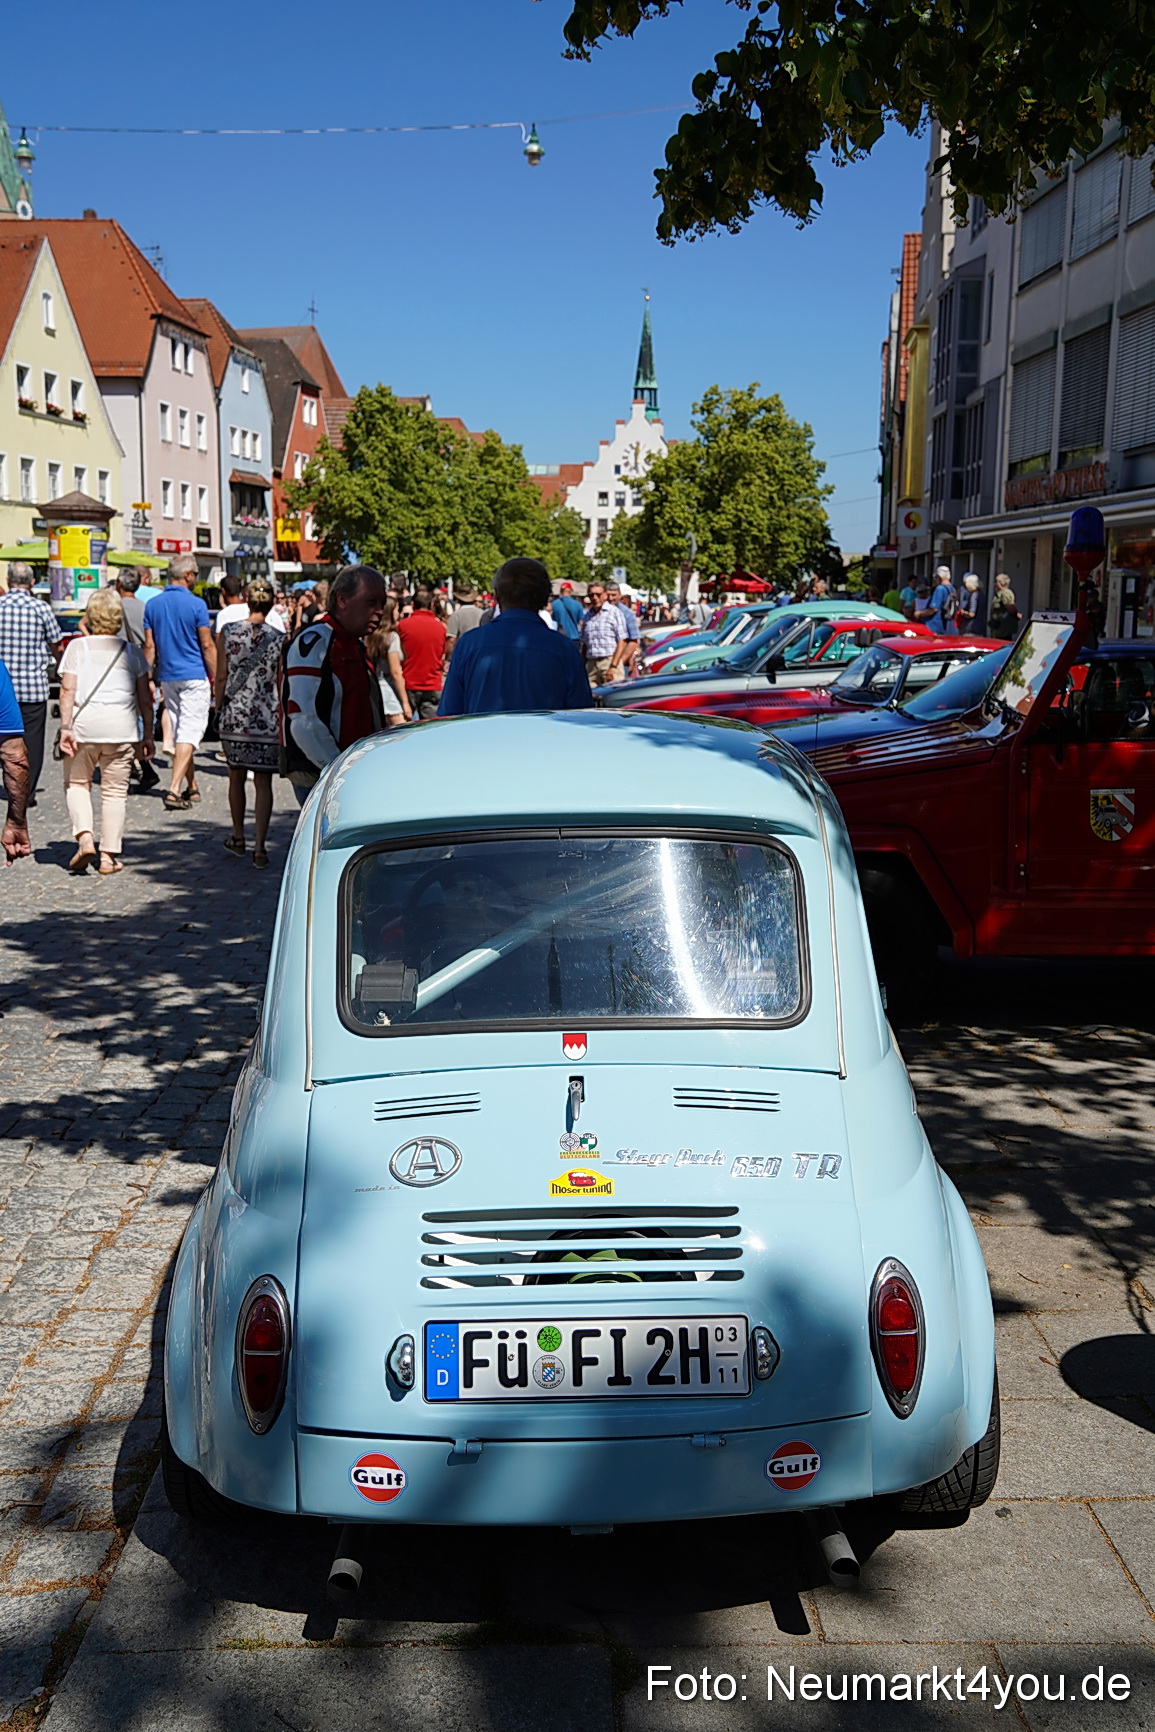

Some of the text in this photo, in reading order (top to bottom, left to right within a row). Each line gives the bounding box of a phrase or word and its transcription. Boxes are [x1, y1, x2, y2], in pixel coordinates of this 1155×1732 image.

[1043, 463, 1106, 500] APOTHEKE
[674, 1149, 726, 1168] Puch
[730, 1155, 783, 1179] 650
[791, 1152, 843, 1180] TR
[714, 1327, 738, 1342] 03
[437, 1369, 449, 1386] D
[718, 1367, 738, 1385] 11
[769, 1457, 818, 1475] Gulf
[353, 1469, 403, 1486] Gulf
